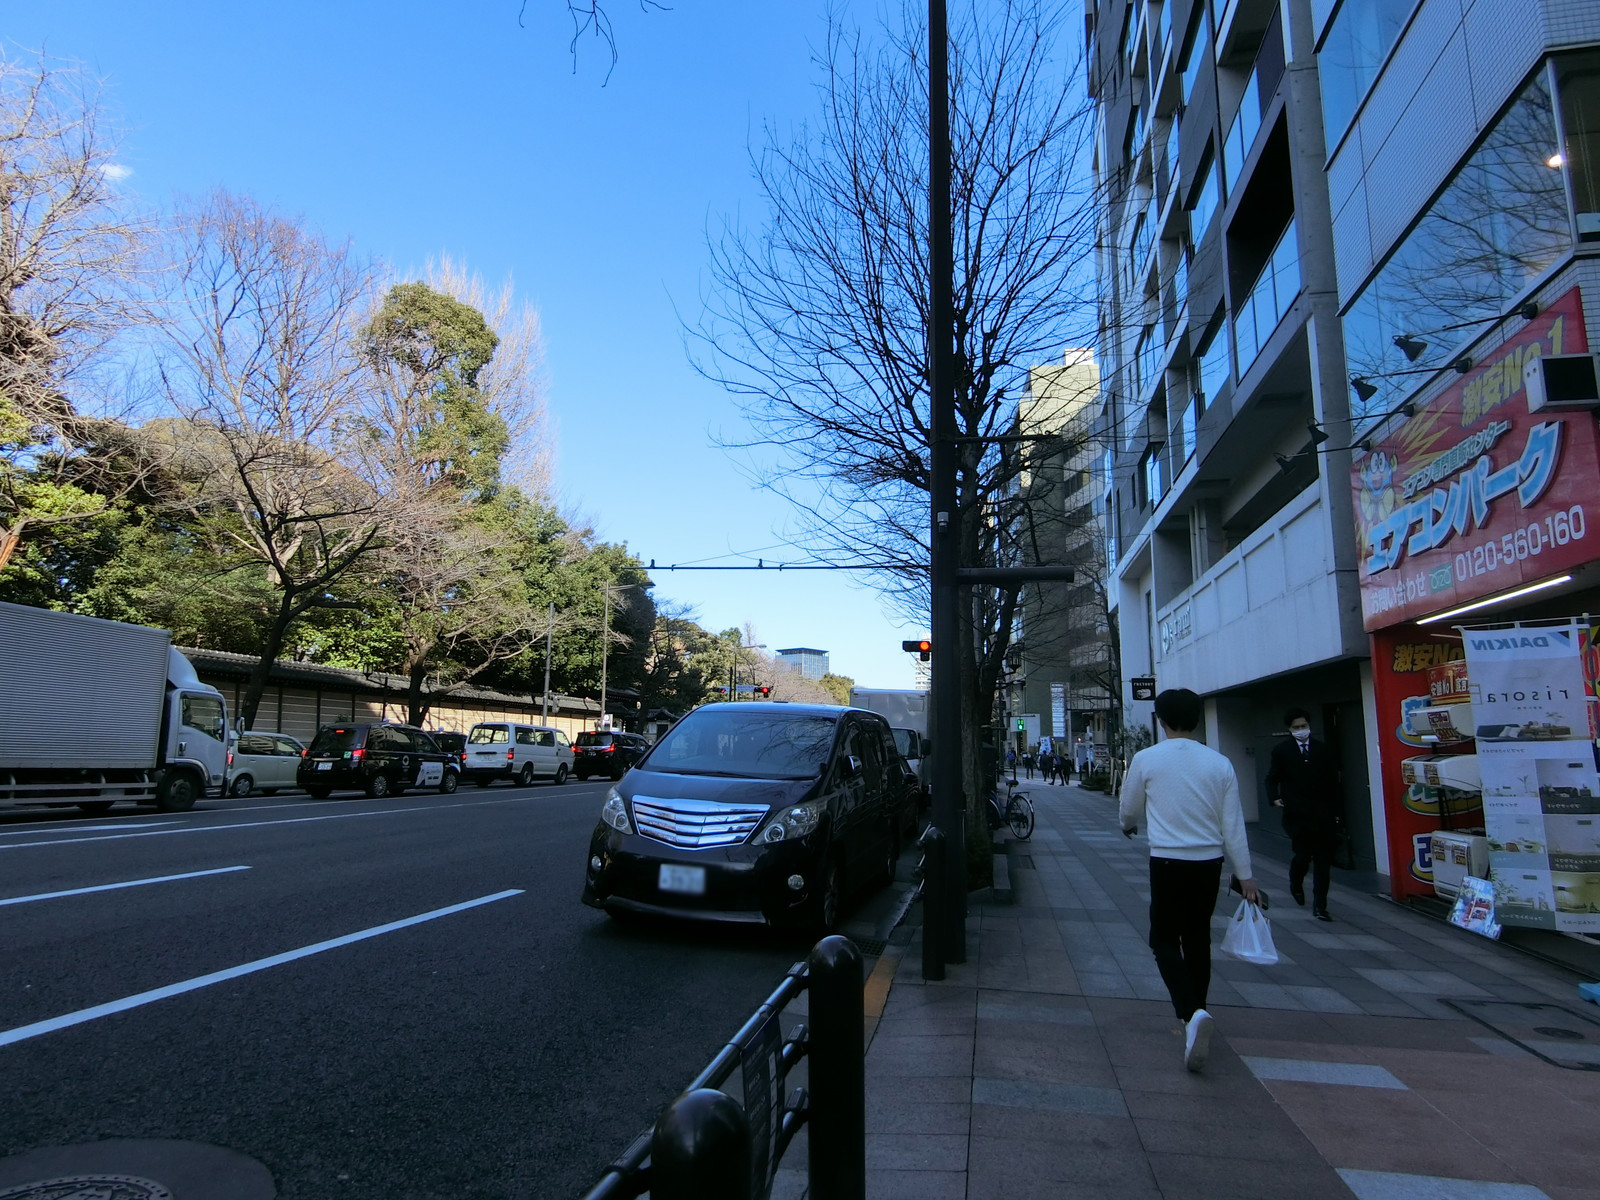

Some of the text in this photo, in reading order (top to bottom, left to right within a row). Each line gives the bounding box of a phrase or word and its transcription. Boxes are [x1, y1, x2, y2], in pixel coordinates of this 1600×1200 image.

[1366, 421, 1563, 575] エアコンパーク
[1455, 504, 1585, 582] 0120-560-160
[1370, 571, 1426, 614] お問い合わせ
